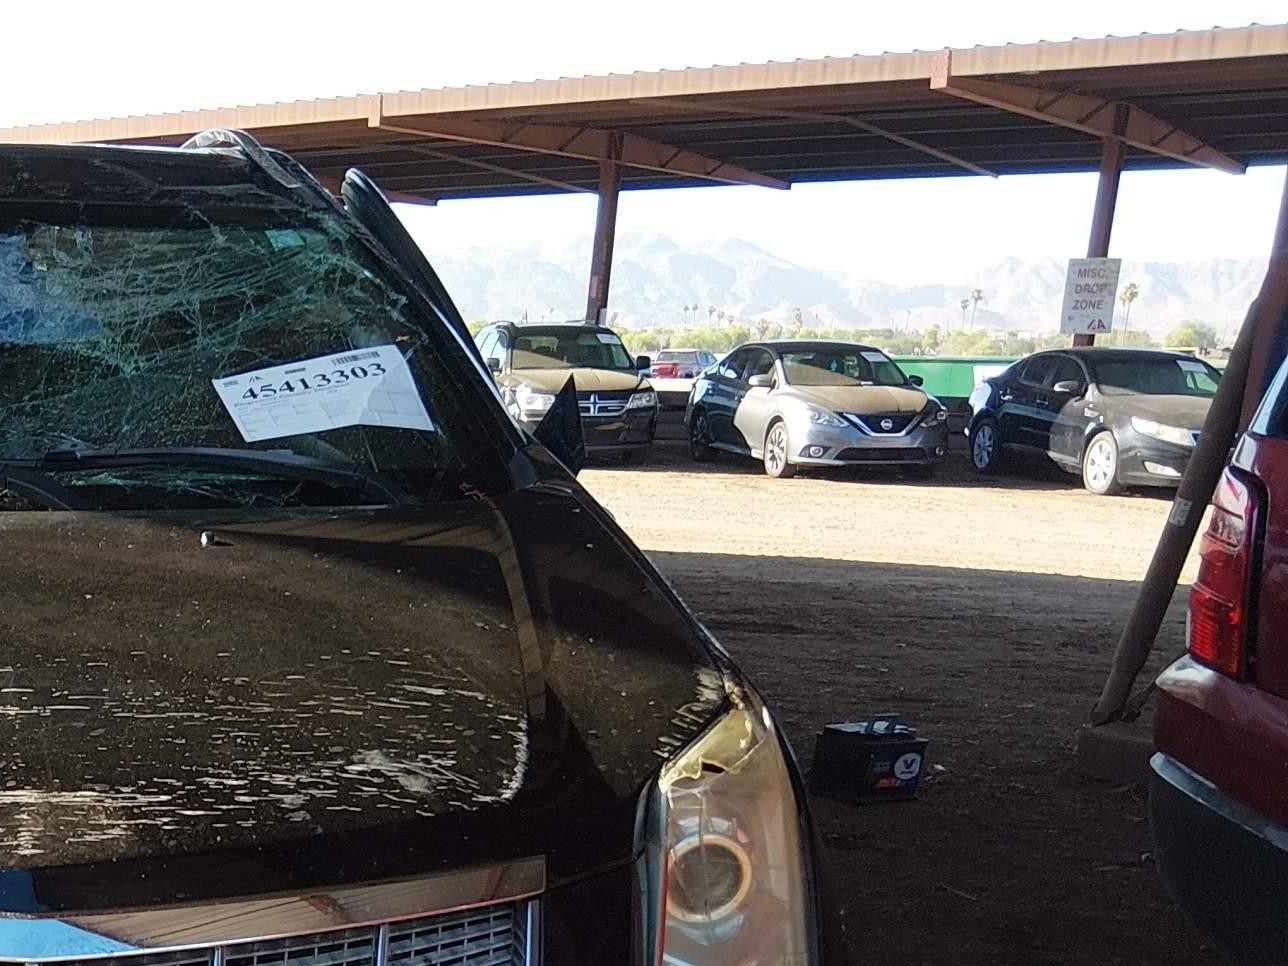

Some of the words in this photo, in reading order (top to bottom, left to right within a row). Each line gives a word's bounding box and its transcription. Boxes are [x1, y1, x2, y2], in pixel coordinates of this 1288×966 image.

[1077, 268, 1106, 279] MISC
[1074, 283, 1107, 294] DROP
[1072, 299, 1104, 310] ZONE
[241, 362, 387, 400] 45413303
